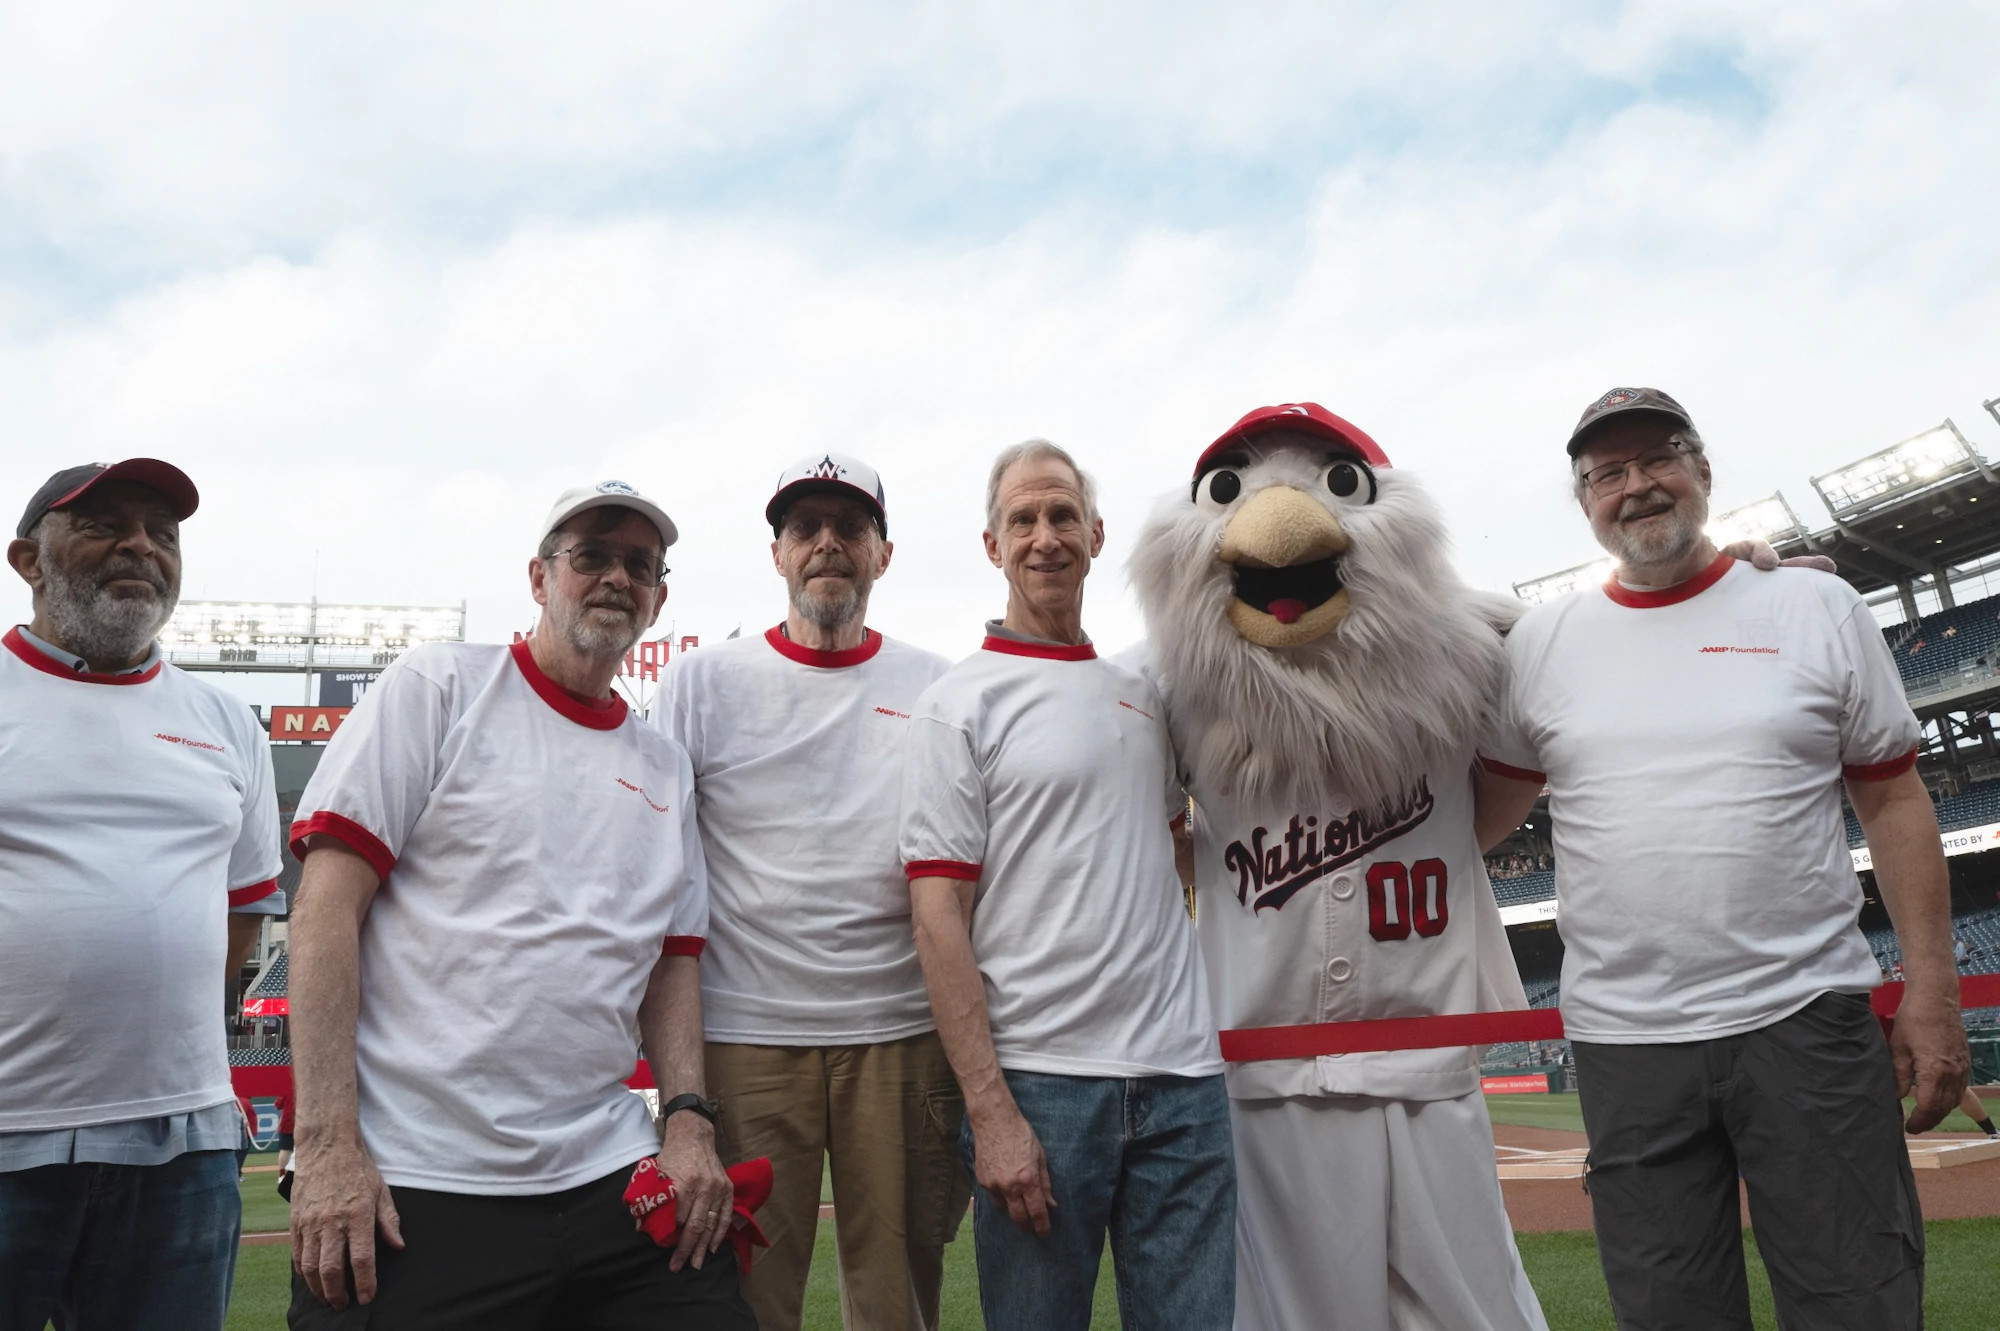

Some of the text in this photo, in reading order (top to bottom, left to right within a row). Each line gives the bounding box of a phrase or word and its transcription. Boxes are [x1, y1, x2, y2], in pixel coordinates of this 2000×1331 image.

[1730, 646, 1780, 654] Foundation
[873, 707, 896, 716] AARP
[154, 733, 225, 752] AARP Foundation
[1971, 834, 1983, 845] BY
[1366, 858, 1448, 942] 00
